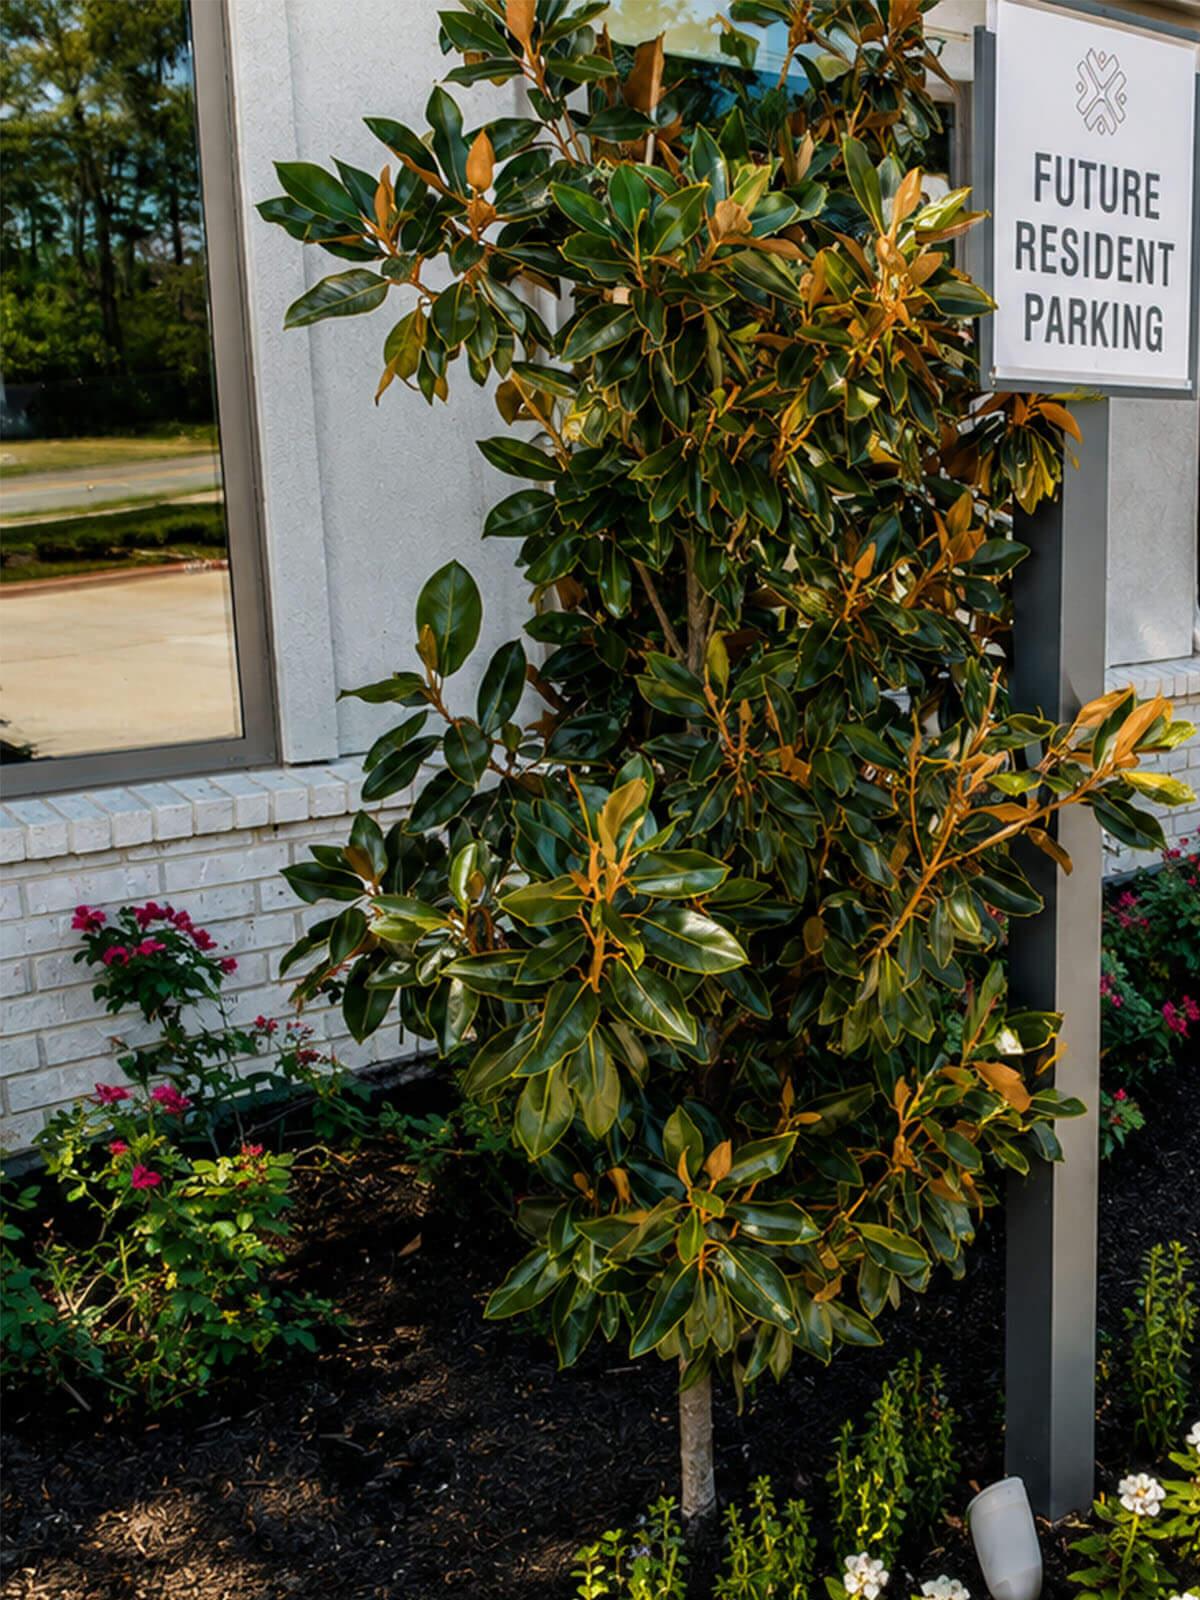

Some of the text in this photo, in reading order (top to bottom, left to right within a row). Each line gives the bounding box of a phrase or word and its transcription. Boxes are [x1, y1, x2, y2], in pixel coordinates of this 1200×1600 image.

[1035, 152, 1160, 220] FUTURE
[1015, 220, 1175, 287] RESIDENT
[1025, 292, 1163, 353] PARKING
